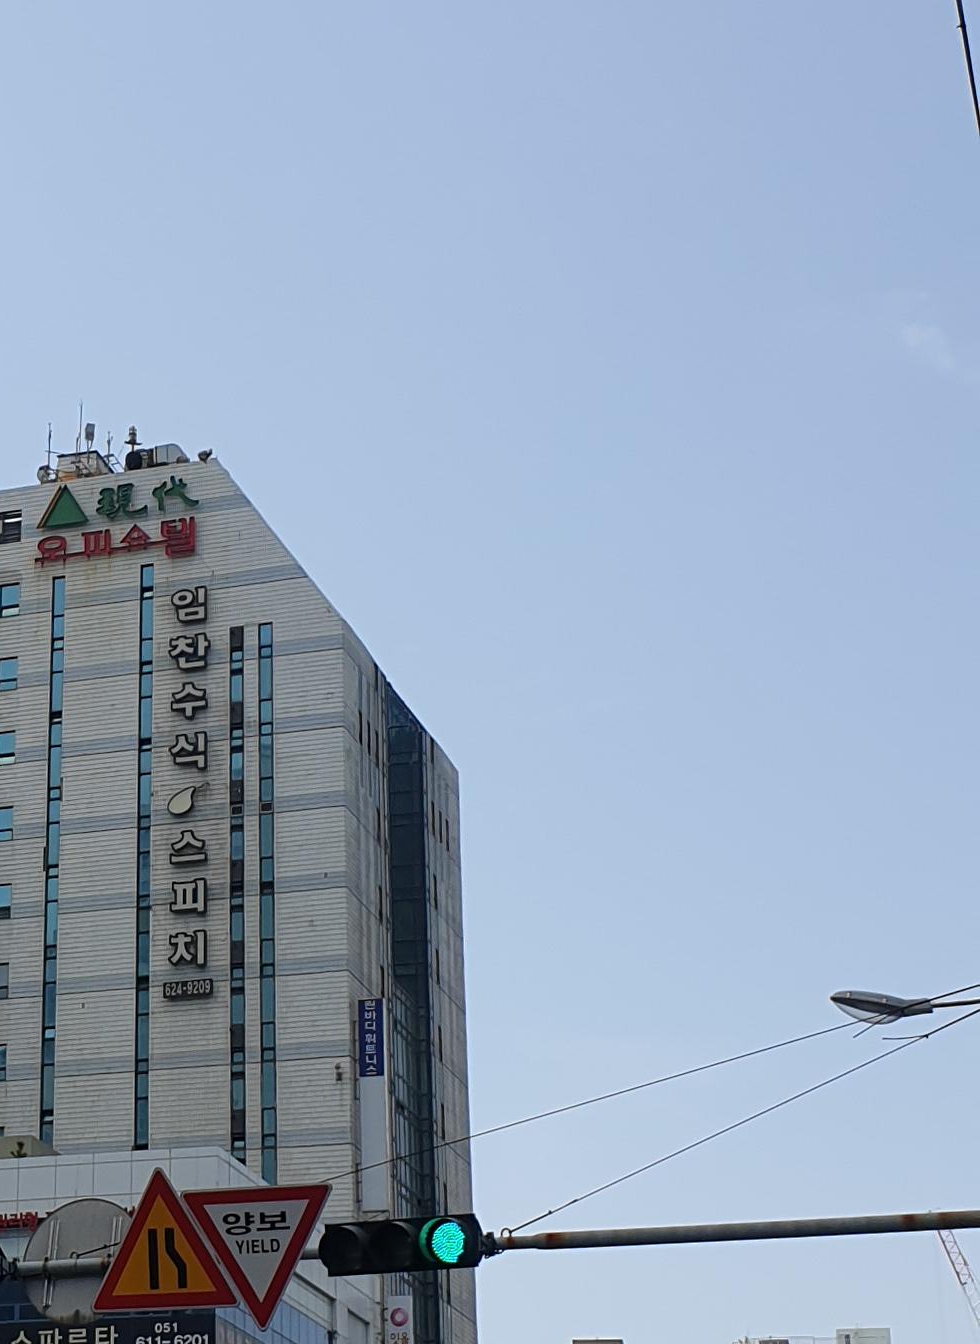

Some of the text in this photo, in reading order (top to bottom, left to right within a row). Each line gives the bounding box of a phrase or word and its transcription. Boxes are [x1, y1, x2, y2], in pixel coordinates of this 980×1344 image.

[96, 475, 199, 520] 現代
[35, 516, 197, 568] 오피스텔
[168, 586, 211, 970] 임찬수식 스피치
[164, 979, 212, 997] 624-9209
[222, 1210, 291, 1236] 양보
[235, 1238, 281, 1255] YIELD
[154, 1322, 179, 1334] 051
